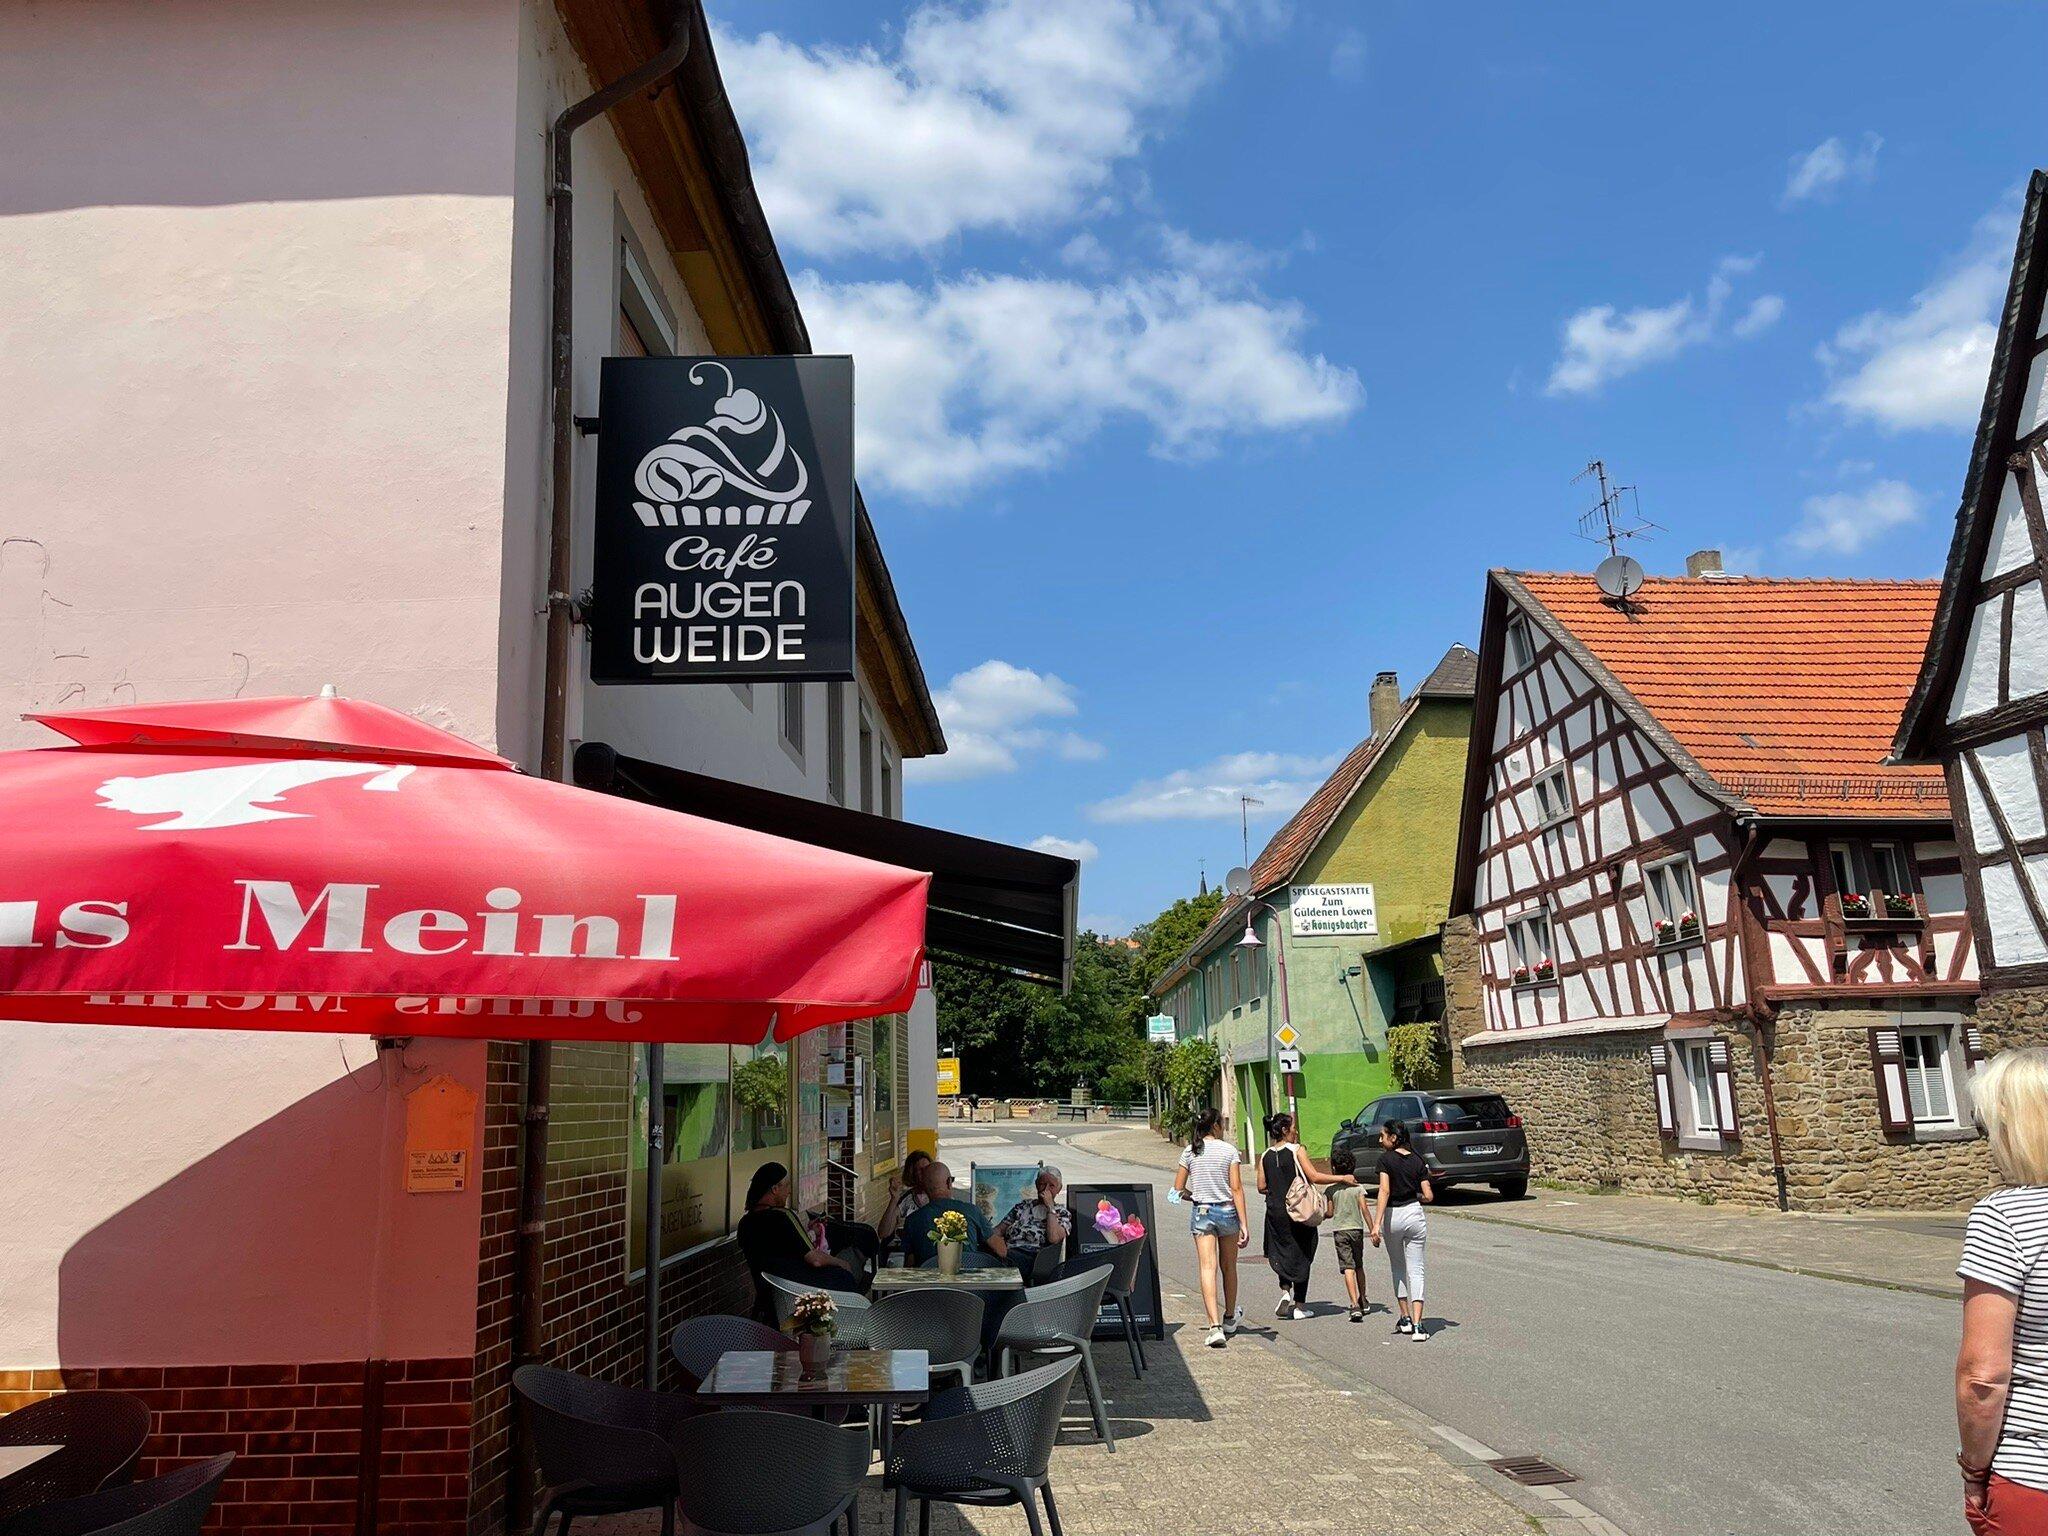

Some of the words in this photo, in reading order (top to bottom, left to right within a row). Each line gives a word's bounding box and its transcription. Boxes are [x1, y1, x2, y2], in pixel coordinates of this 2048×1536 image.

[665, 533, 778, 580] Café
[634, 580, 806, 620] AUGEN
[633, 624, 806, 664] WEIDE
[222, 878, 681, 962] Meinl
[1294, 907, 1339, 917] Güldenen
[1321, 897, 1343, 907] Zum
